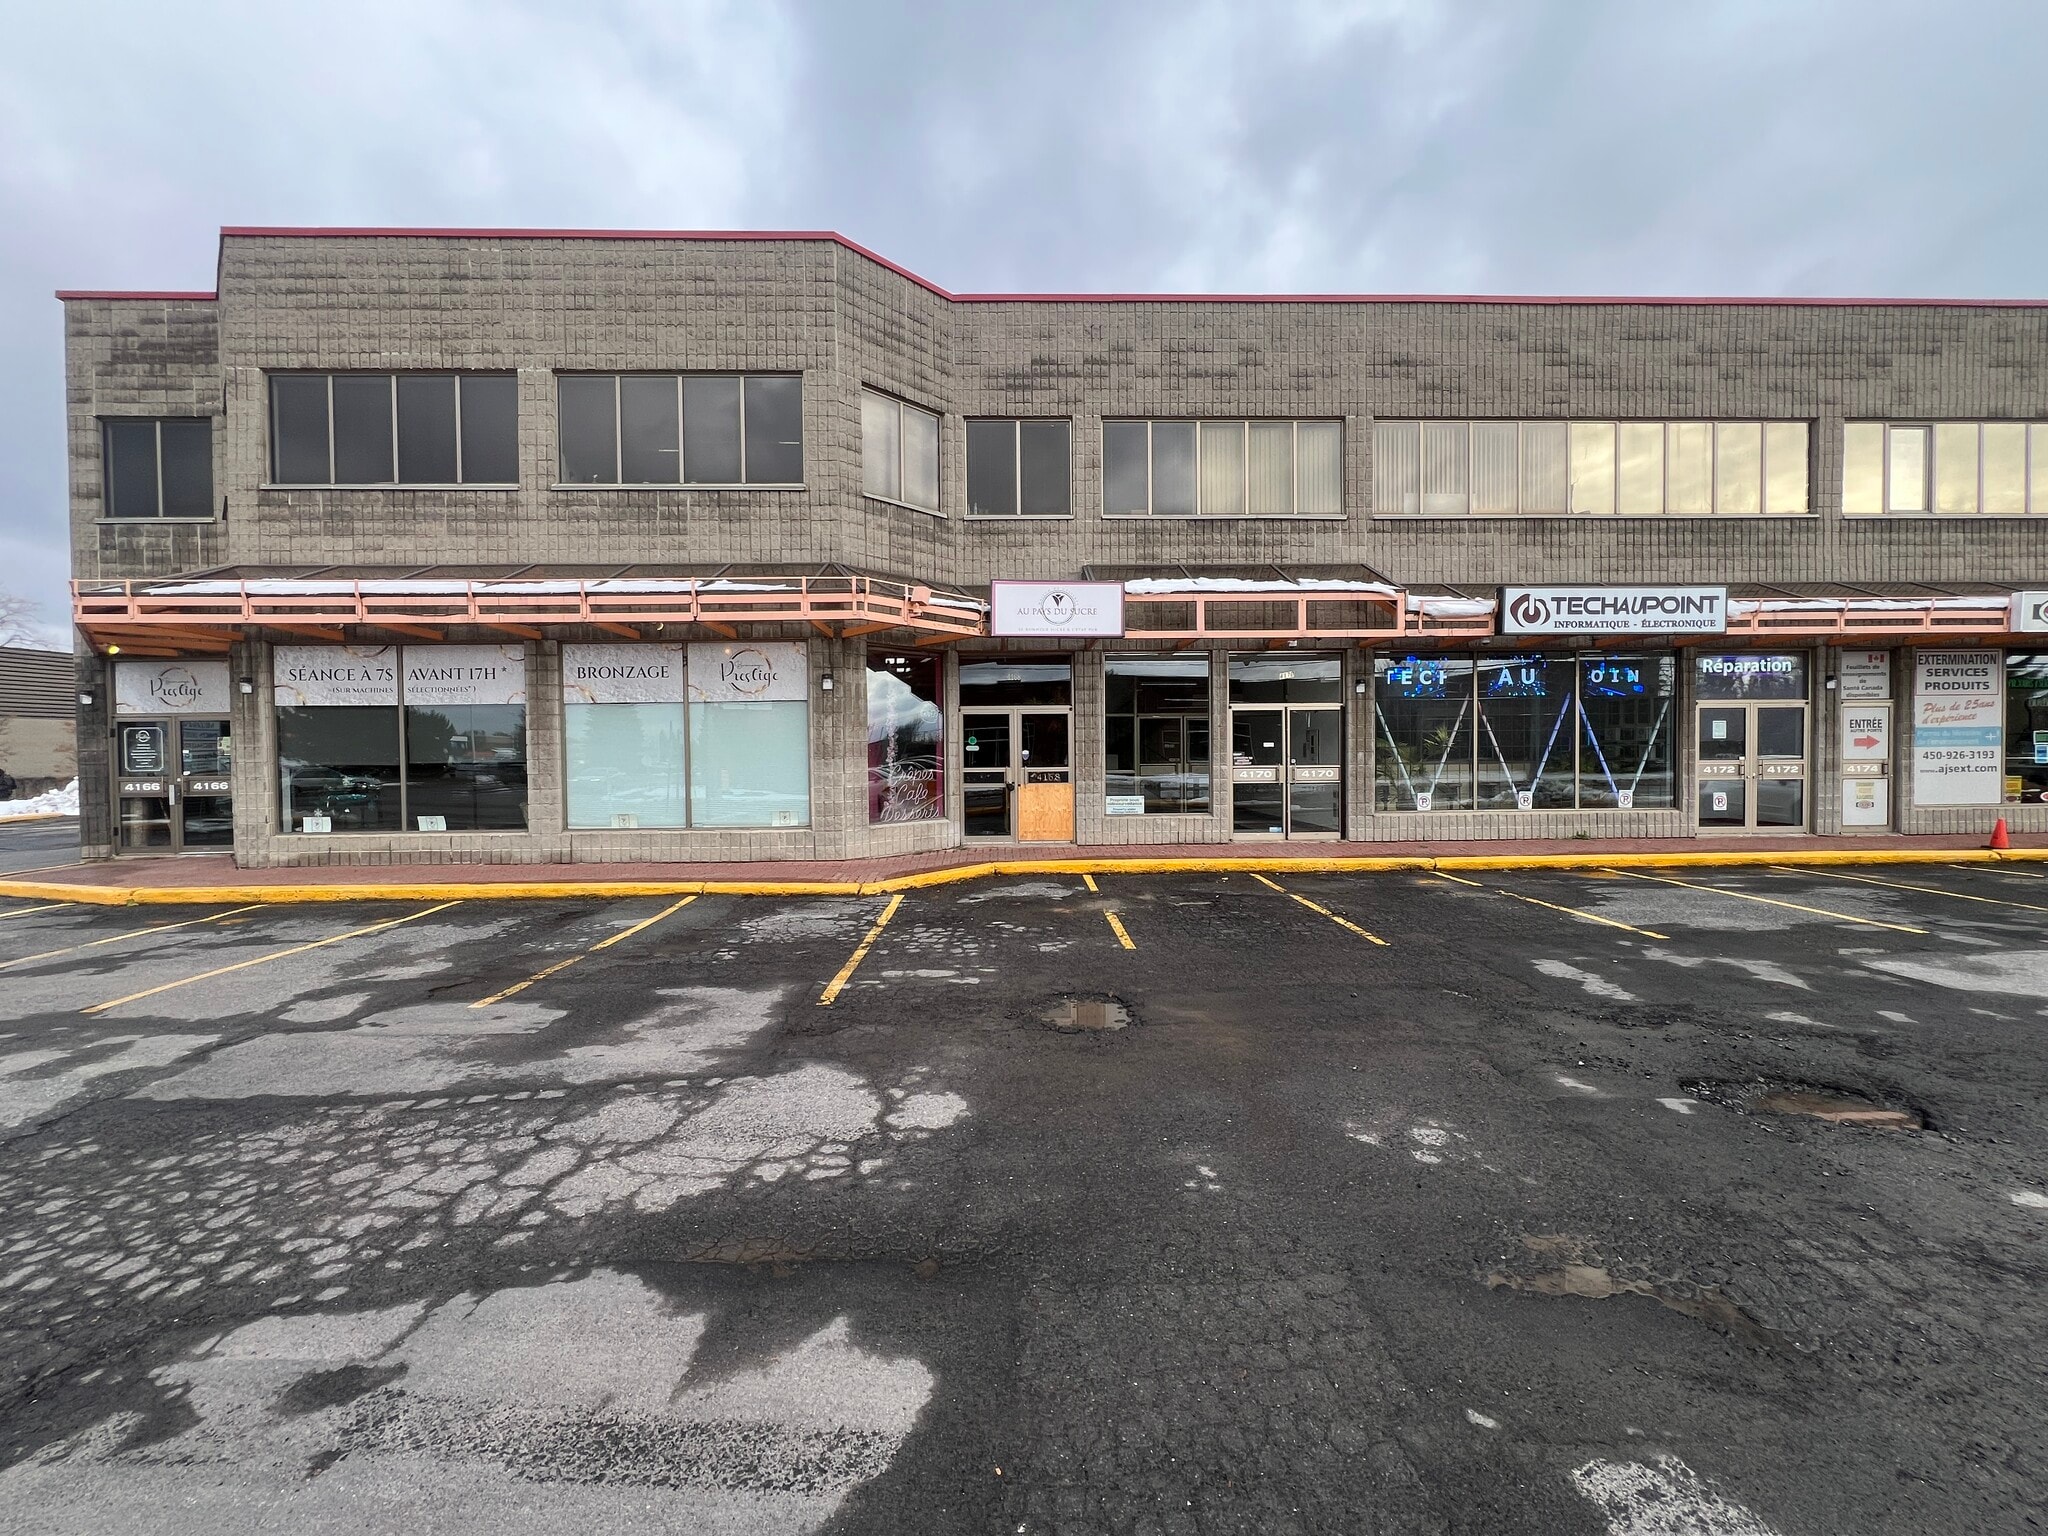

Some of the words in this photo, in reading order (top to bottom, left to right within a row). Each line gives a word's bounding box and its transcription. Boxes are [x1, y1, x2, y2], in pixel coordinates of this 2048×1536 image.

[1551, 596, 1720, 615] TECHAUPOINT
[1017, 607, 1030, 616] AU
[1032, 607, 1052, 616] PAYS
[1054, 607, 1067, 616] DU
[1070, 607, 1098, 616] SUCRE
[1554, 620, 1630, 629] INFORMATIQUE
[1641, 618, 1717, 629] ÉLECTRONIQUE
[1918, 654, 1997, 665] EXTERMINATION
[577, 665, 670, 679] BRONZAGE
[1702, 658, 1792, 677] Réparation
[1926, 668, 1989, 677] SERVICES
[288, 665, 356, 682] SÉANCE
[360, 665, 372, 681] À
[376, 667, 394, 682] 7$
[408, 667, 465, 681] AVANT
[470, 667, 496, 680] 17H
[1498, 667, 1536, 685] AU
[1925, 681, 1990, 691] PRODUITS
[1923, 702, 1946, 714] Plus
[1949, 702, 1961, 711] de
[1849, 717, 1883, 729] ENTRÉE
[1922, 750, 1995, 760] 450-926-3193
[1240, 770, 1272, 778] 4170
[1301, 769, 1334, 778] 4170
[1703, 766, 1736, 774] 4172
[1767, 766, 1799, 774] 4172
[124, 782, 161, 791] 4166
[193, 781, 229, 790] 4166
[880, 803, 941, 822] Desserts
